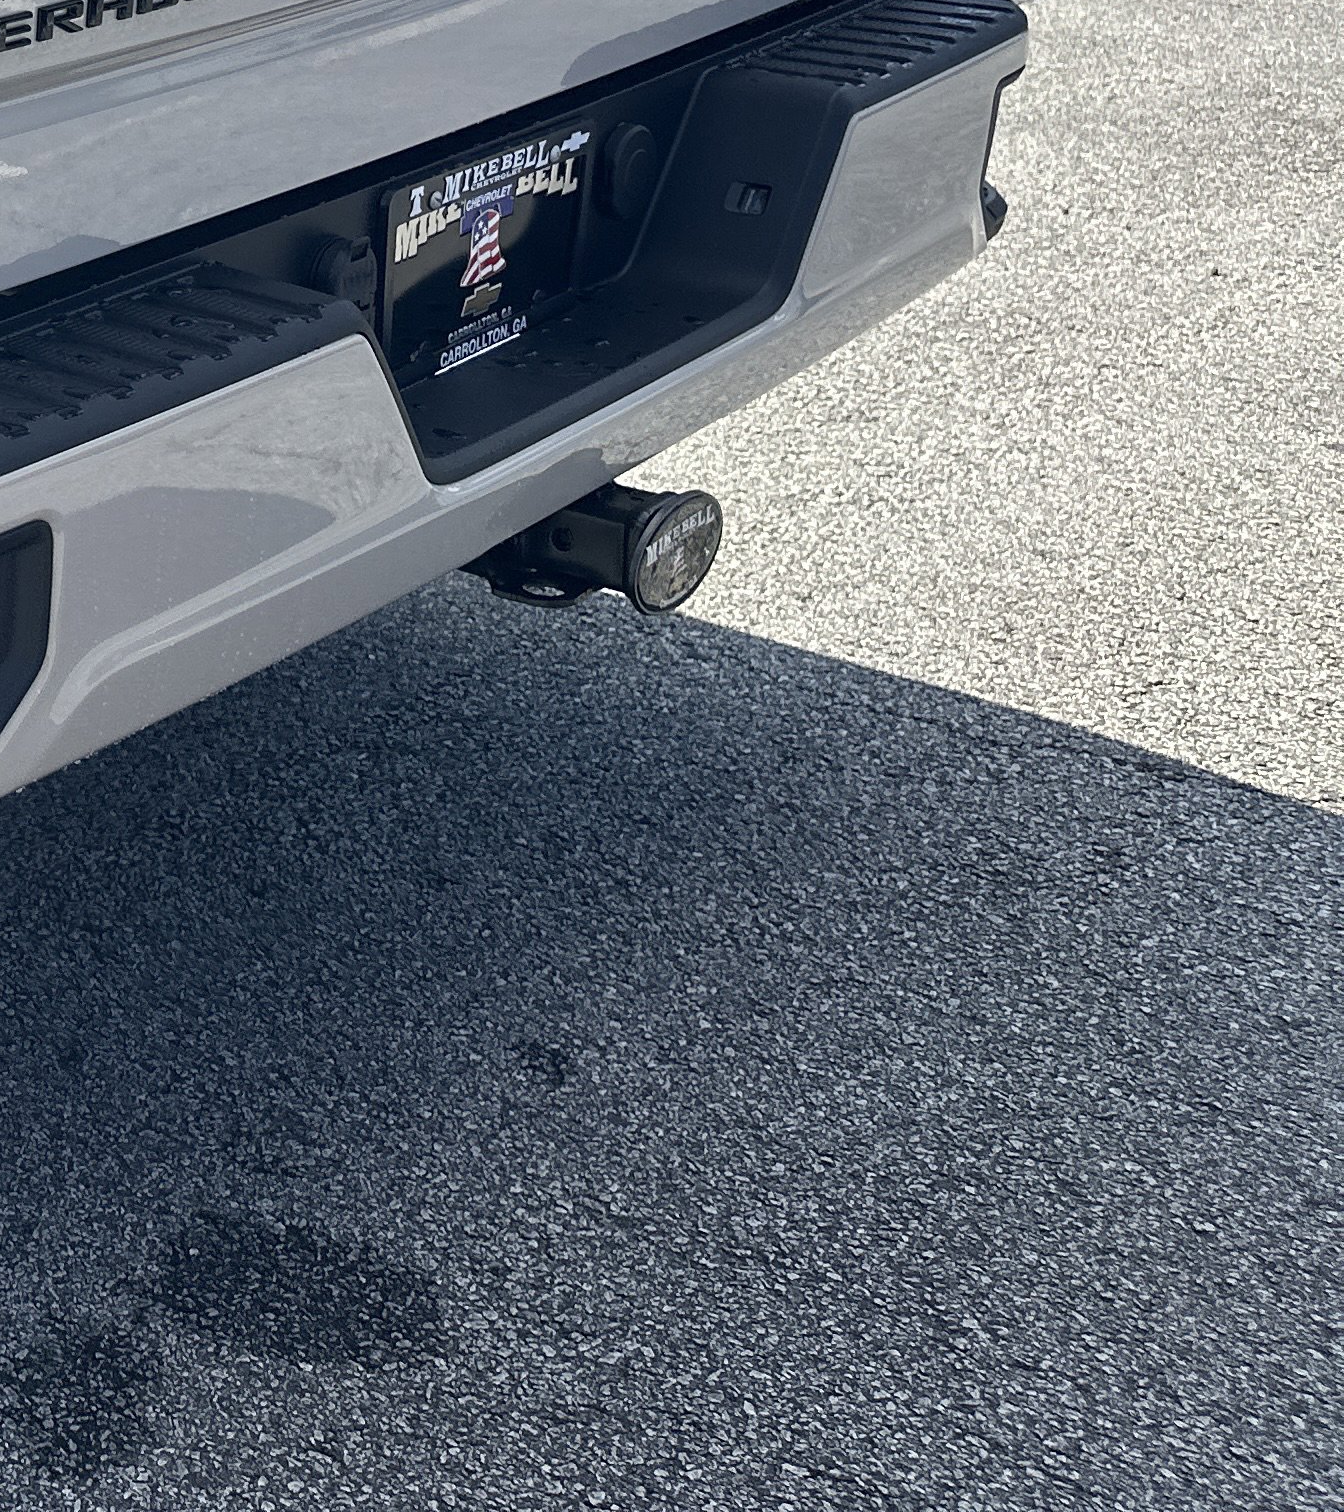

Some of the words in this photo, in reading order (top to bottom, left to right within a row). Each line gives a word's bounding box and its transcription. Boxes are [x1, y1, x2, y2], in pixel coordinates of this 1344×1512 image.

[442, 158, 500, 204] MIKE
[501, 140, 550, 171] BELL
[471, 167, 522, 190] CHEVROLET
[466, 184, 513, 211] CHEVROLET
[512, 315, 527, 333] GA
[646, 524, 680, 567] MIKE
[681, 504, 715, 533] BELL
